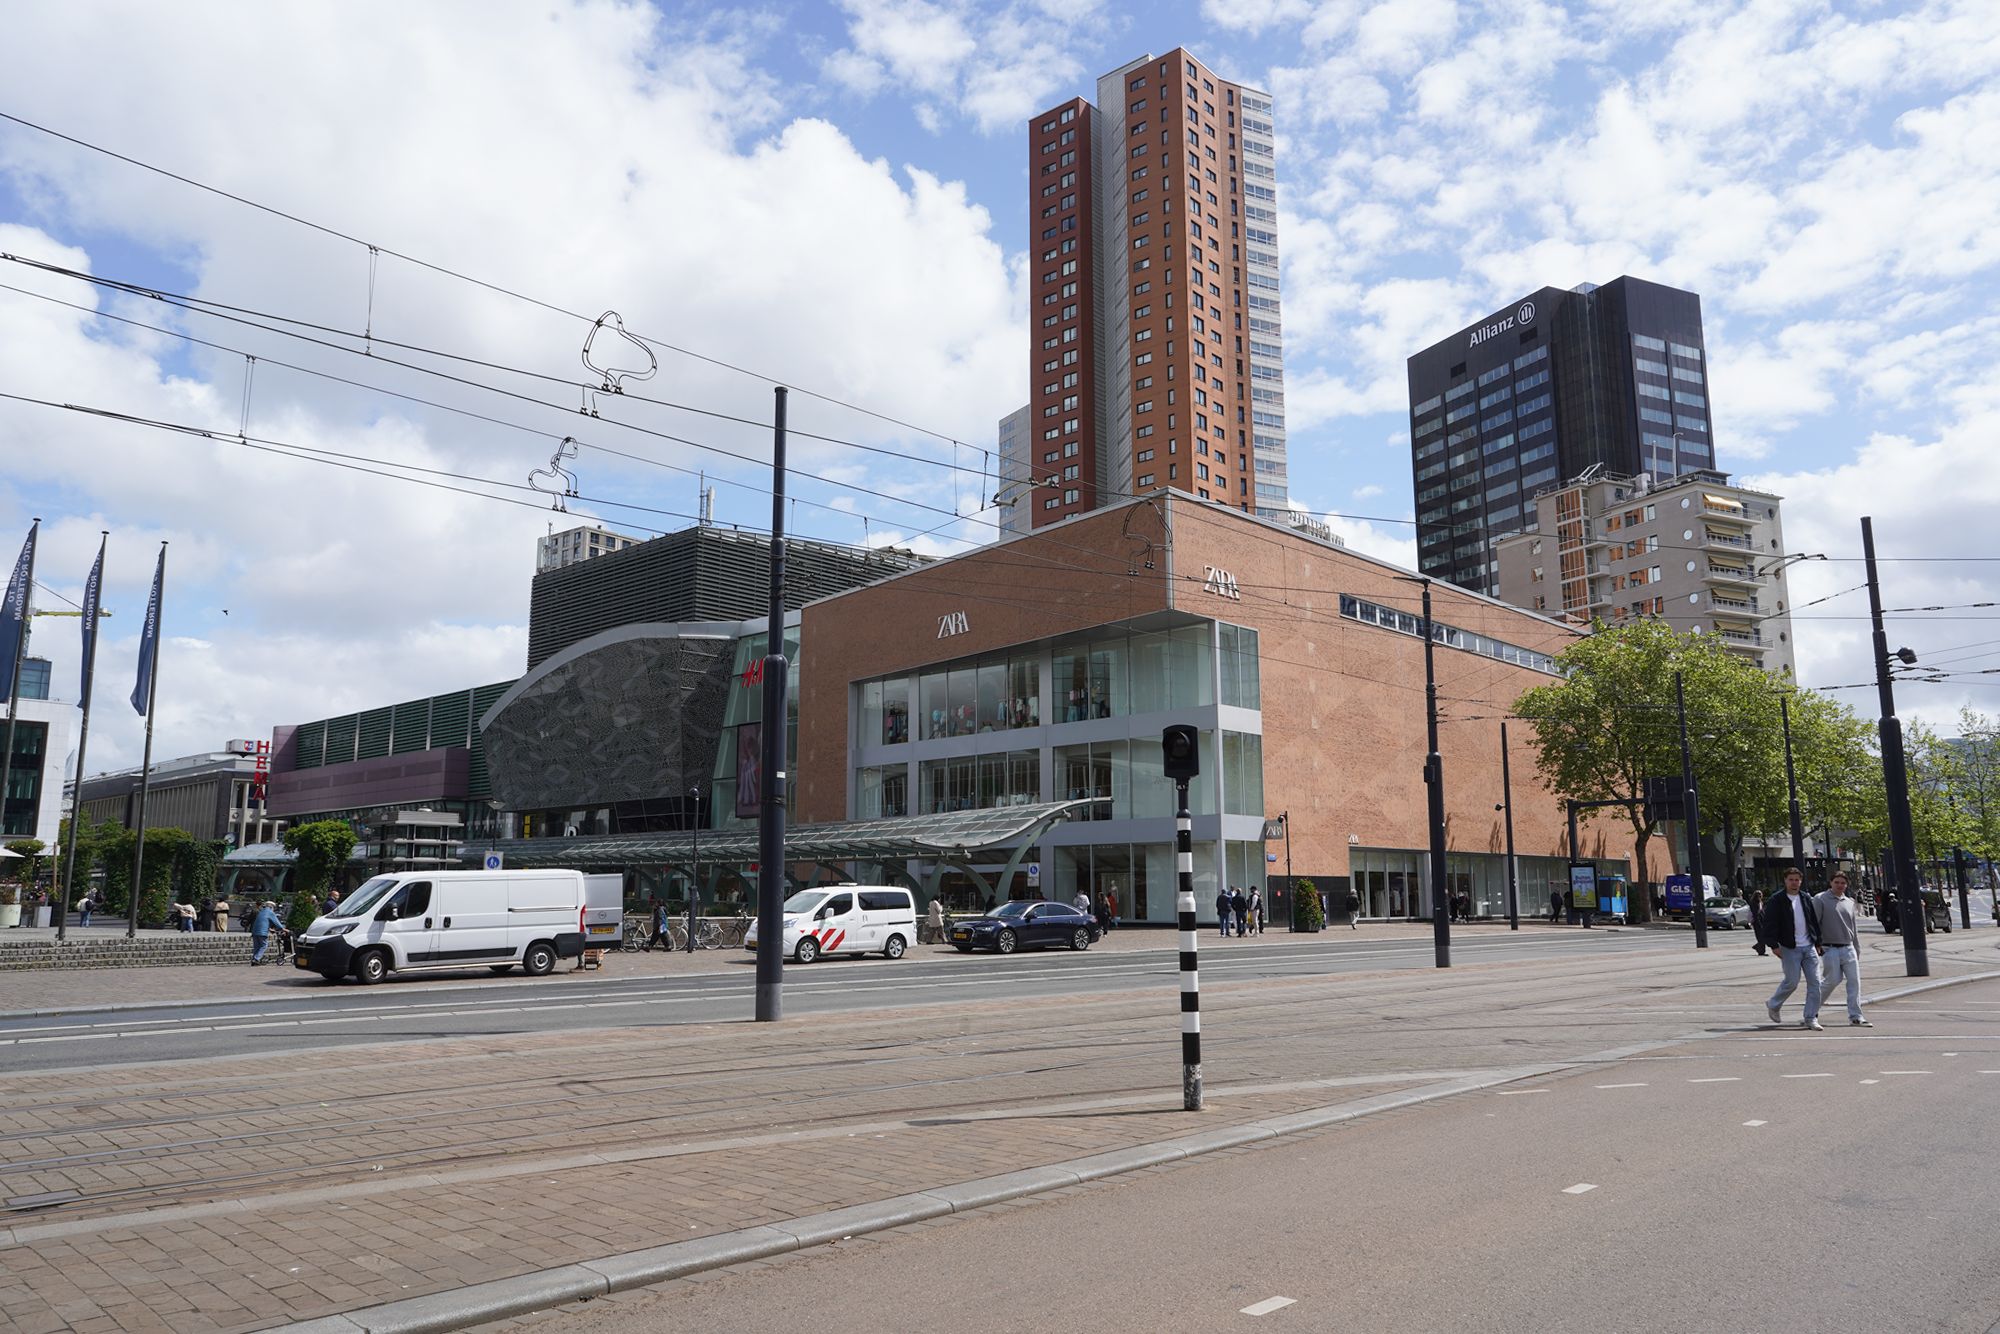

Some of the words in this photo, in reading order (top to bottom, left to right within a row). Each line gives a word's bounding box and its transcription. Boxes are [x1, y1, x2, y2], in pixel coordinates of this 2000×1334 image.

[1469, 316, 1515, 348] Allianz
[1203, 565, 1240, 599] ZARA
[937, 609, 970, 639] ZARA
[252, 740, 270, 801] HEMA
[1806, 860, 1827, 868] AFÉ
